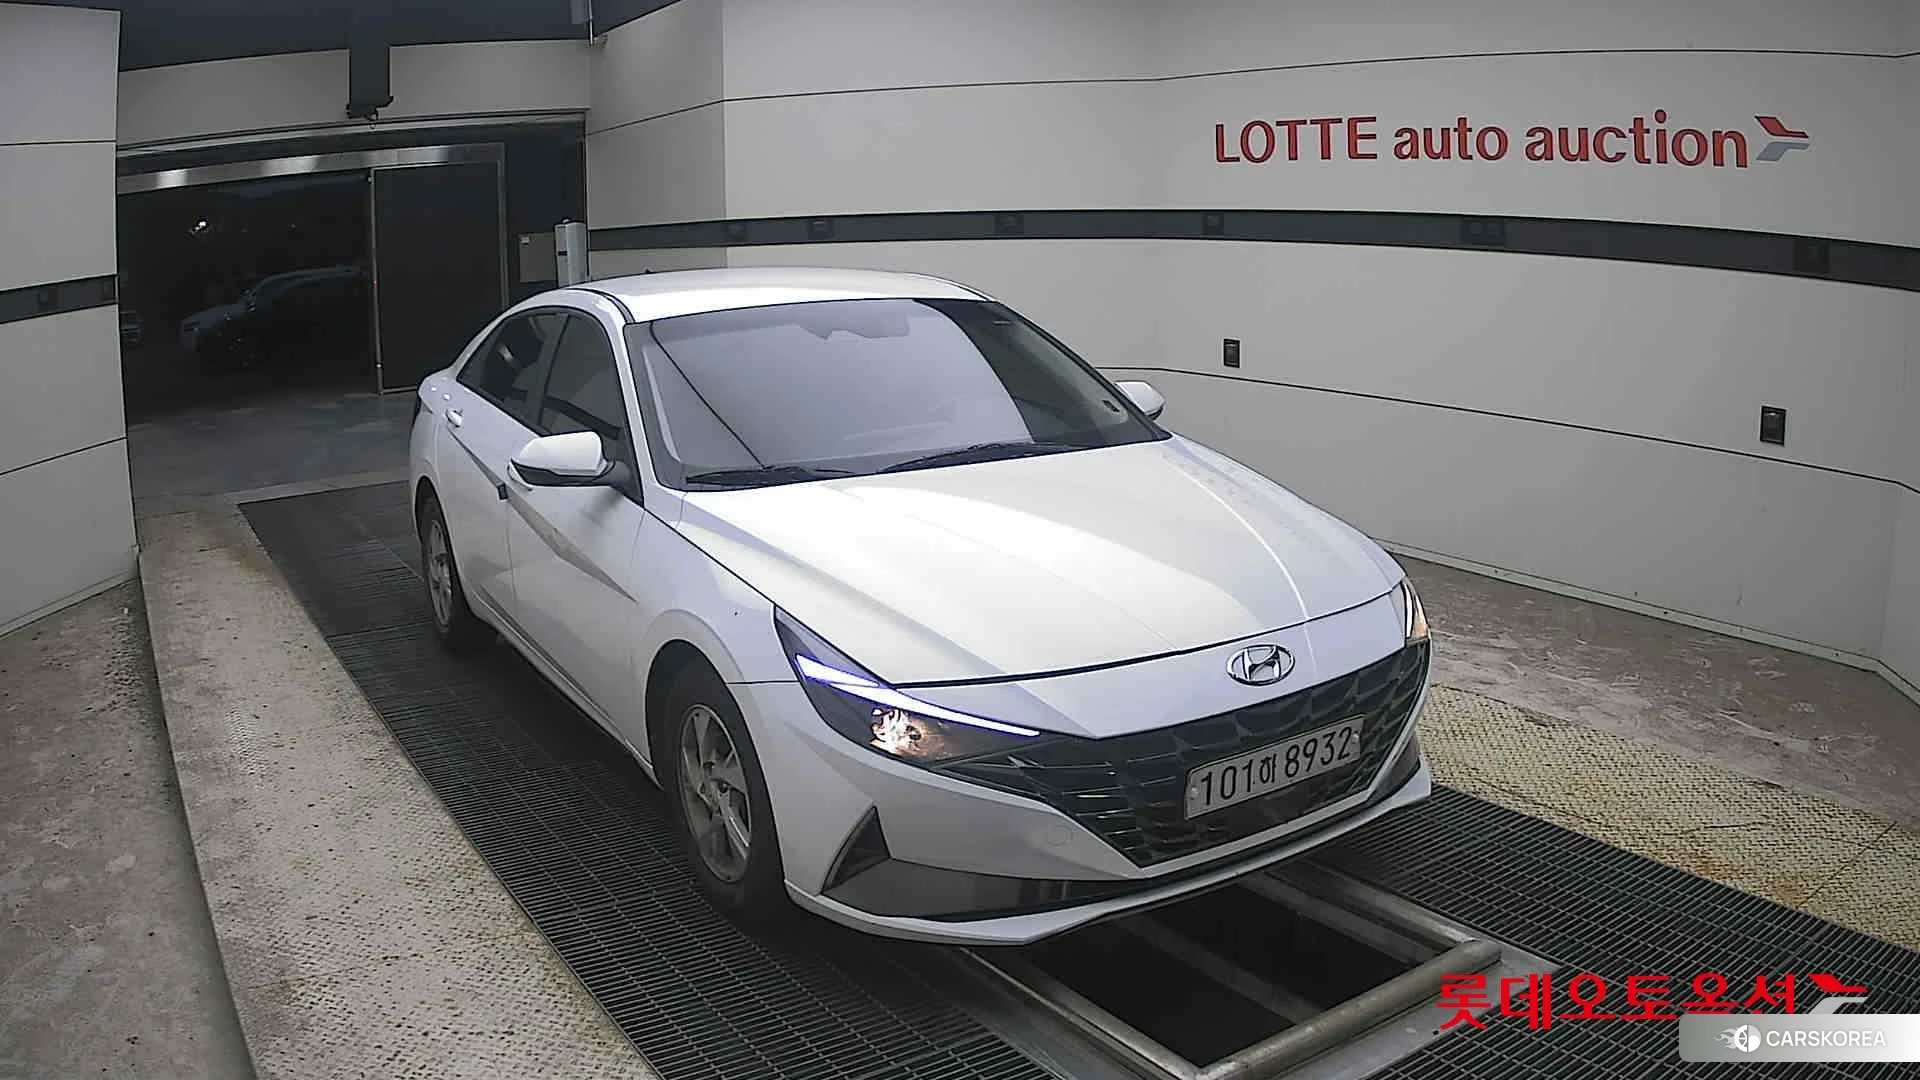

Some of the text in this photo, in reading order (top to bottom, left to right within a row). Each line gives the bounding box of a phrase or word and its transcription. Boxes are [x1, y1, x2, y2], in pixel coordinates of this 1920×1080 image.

[1215, 109, 1748, 169] LOTTE auto auction
[1284, 726, 1353, 778] 8932
